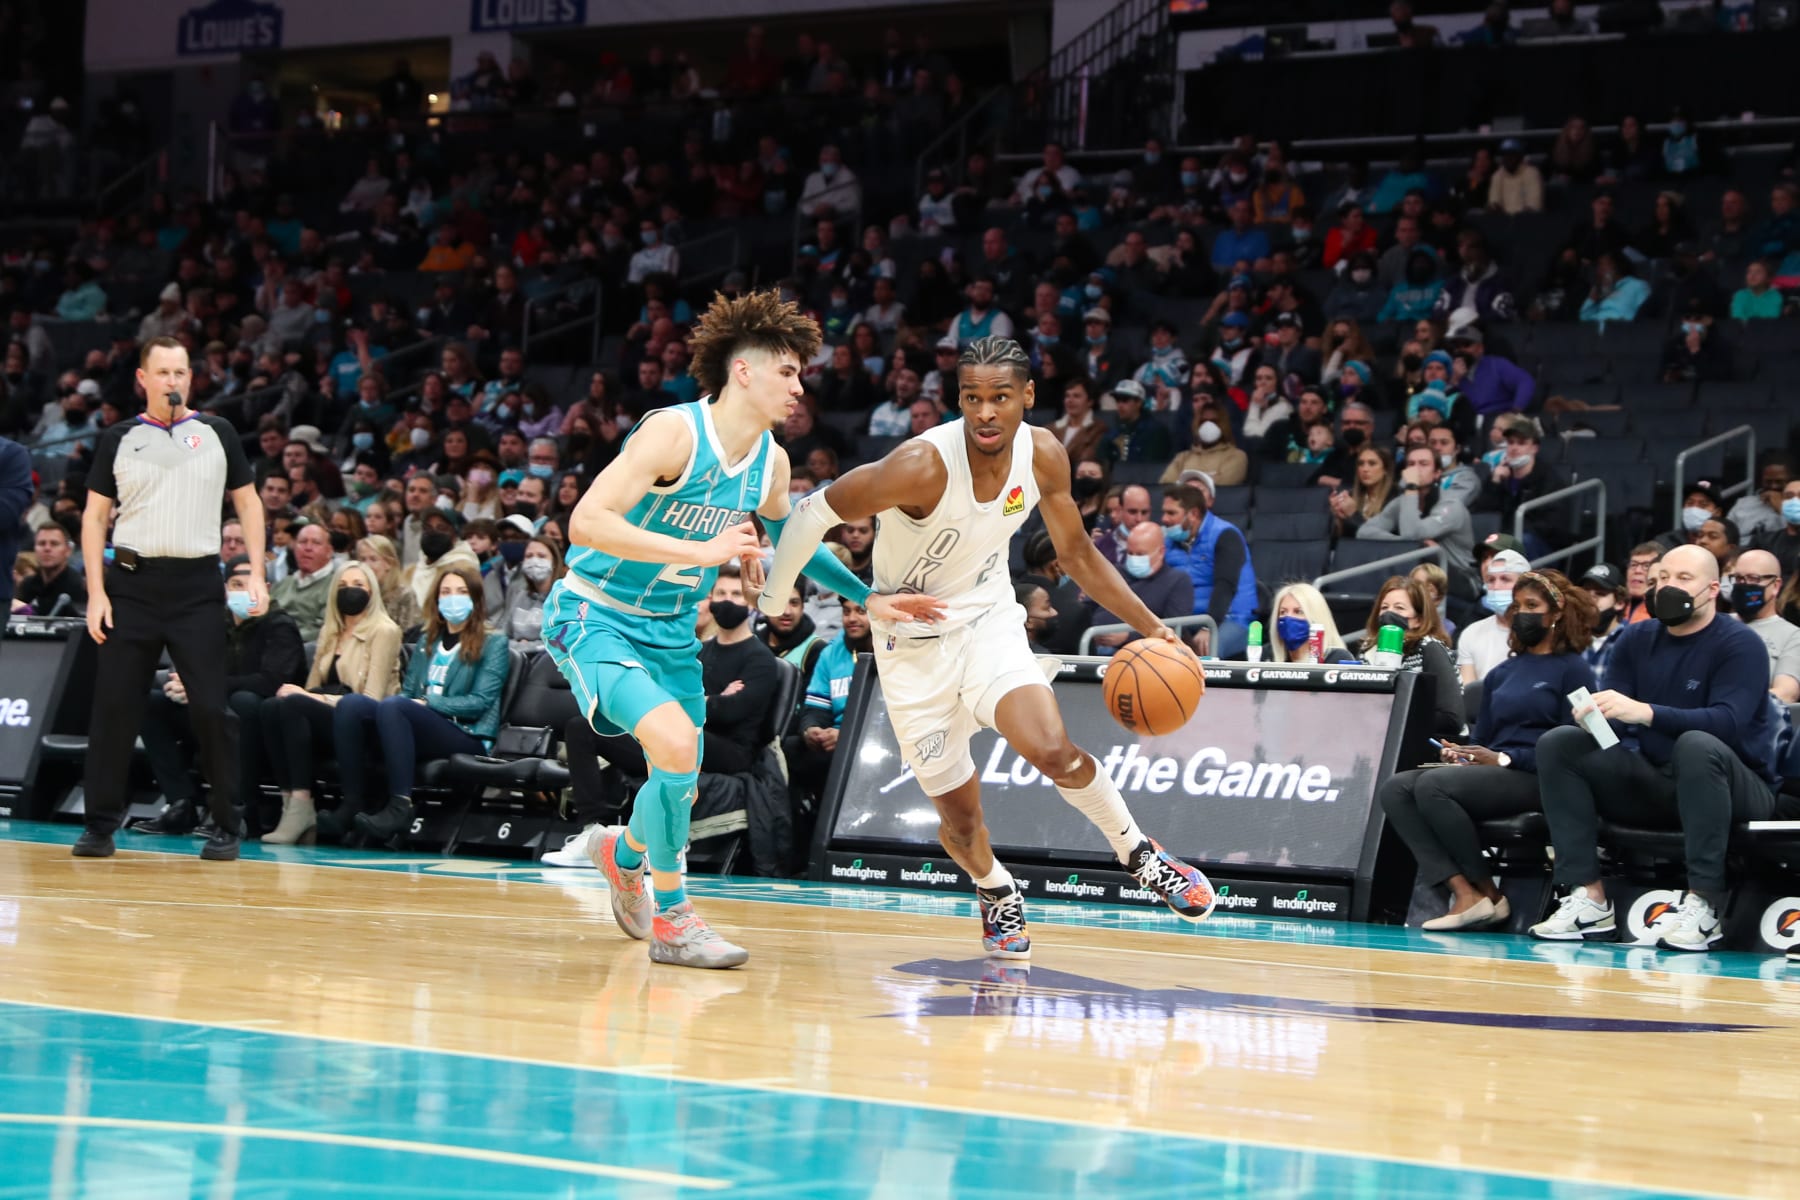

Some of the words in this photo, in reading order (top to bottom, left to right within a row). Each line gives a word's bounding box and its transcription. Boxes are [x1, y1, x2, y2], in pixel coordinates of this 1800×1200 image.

[480, 0, 577, 26] LOWES
[185, 15, 275, 50] LOWE'S
[1262, 670, 1310, 680] GATORADE
[1341, 672, 1390, 682] GATORADE
[830, 676, 853, 698] HA
[981, 737, 1054, 786] Lo
[1104, 745, 1178, 794] the
[1183, 747, 1340, 802] Game.
[410, 818, 424, 834] 5
[498, 823, 512, 839] 6
[832, 864, 887, 881] lendingtree
[901, 869, 957, 885] lendingtree
[1046, 879, 1104, 897] lendingtree
[1120, 885, 1165, 904] lending
[1273, 896, 1337, 912] lendingtree
